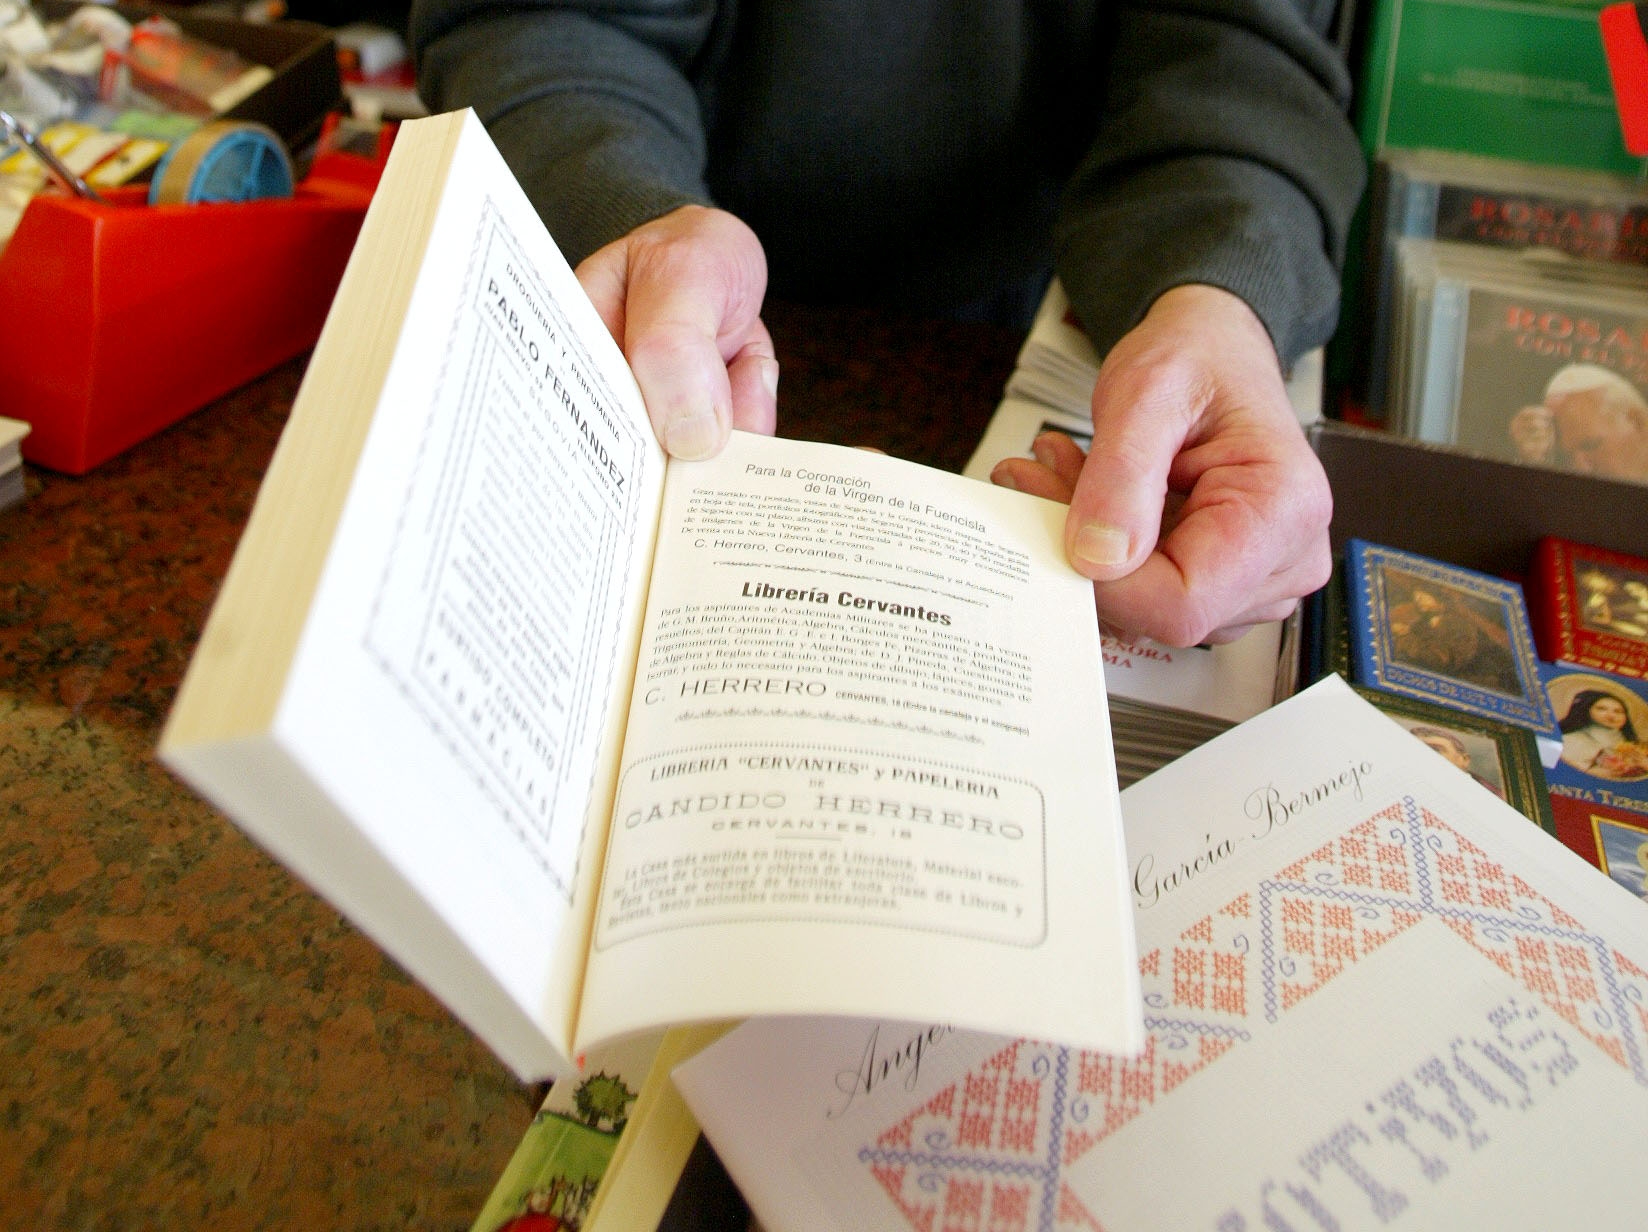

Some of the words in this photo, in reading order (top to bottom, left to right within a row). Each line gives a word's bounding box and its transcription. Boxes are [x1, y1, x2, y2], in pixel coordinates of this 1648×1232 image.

[505, 260, 556, 347] DROGUERIA
[570, 359, 620, 444] PERFUMERIA
[487, 275, 540, 366] PABLO
[544, 360, 625, 497] FERNANDEZ
[528, 382, 578, 465] SEGOVIA
[745, 464, 776, 476] Para
[780, 467, 791, 478] la
[796, 469, 871, 489] Coronación
[804, 482, 820, 493] de
[825, 484, 836, 495] la
[843, 487, 883, 504] Virgen
[888, 495, 904, 508] de
[909, 499, 920, 512] la
[925, 504, 986, 532] Fuencisla
[741, 582, 829, 604] Librería
[837, 590, 952, 626] Cervantes
[680, 677, 827, 698] HERRERO
[651, 760, 728, 781] LIBRERIA
[875, 769, 884, 781] y
[892, 768, 999, 799] PAPELERIA
[625, 792, 786, 829] CANDIDO
[815, 794, 1024, 840] HERRERO
